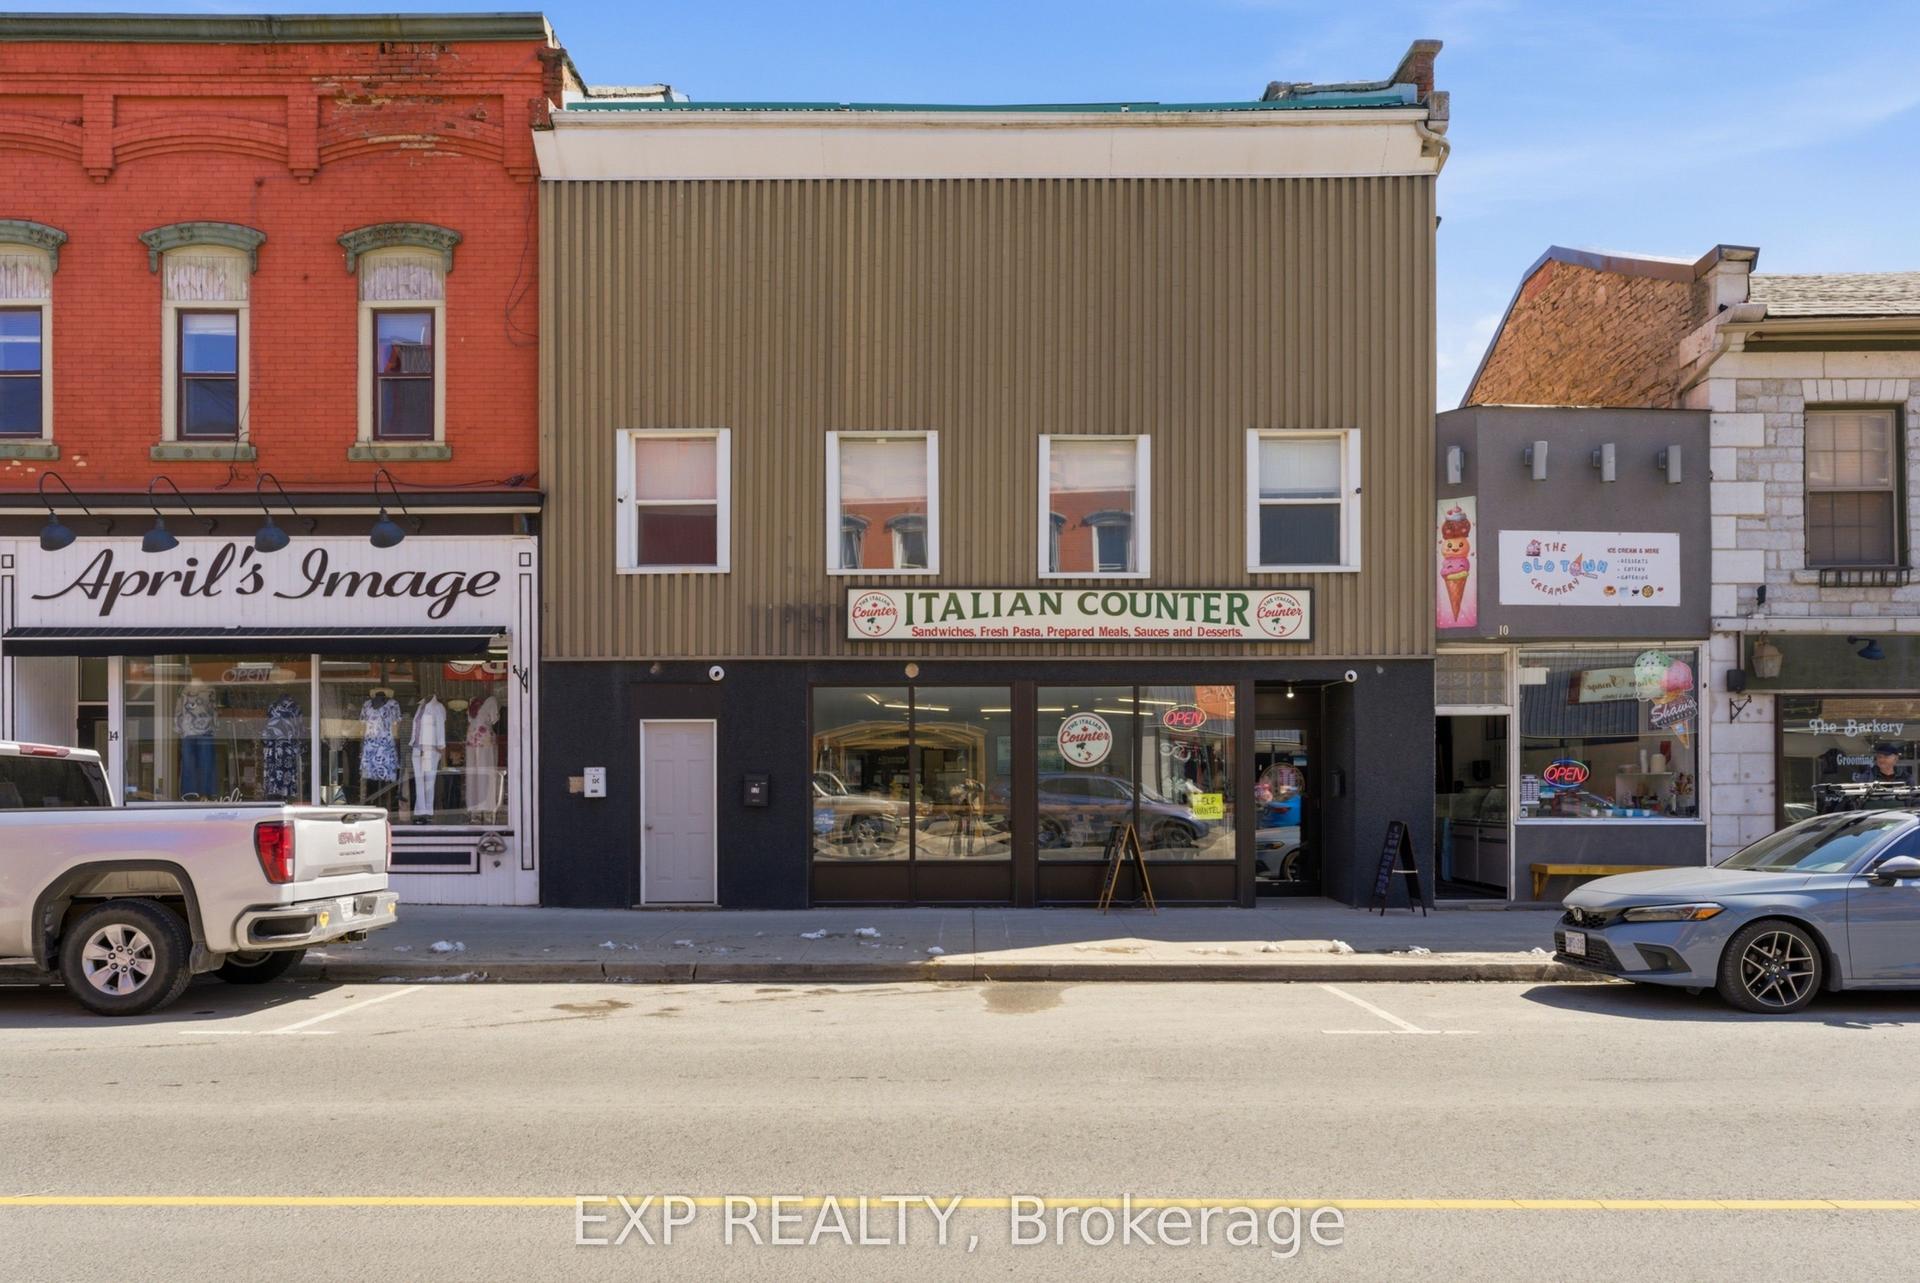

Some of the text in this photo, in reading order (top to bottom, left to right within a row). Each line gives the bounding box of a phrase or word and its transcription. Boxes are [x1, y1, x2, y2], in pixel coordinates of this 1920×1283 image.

[1544, 542, 1567, 552] THE
[1521, 557, 1555, 574] OLD
[31, 542, 501, 620] April's Image
[1530, 578, 1580, 596] CREAMERY
[852, 606, 898, 618] Counter
[904, 591, 1250, 627] ITALIAN COUNTER
[1257, 606, 1303, 619] Counter
[911, 626, 1243, 639] Sandwiches, Fresh Pasta, Prepared Meals, Sauces and Desserts.
[1499, 624, 1509, 636] 10
[222, 668, 270, 683] OPEN
[1067, 719, 1103, 731] THE ITALIAN
[1166, 711, 1202, 726] OPEN
[1808, 718, 1904, 737] The Barkery
[109, 731, 119, 741] 14
[1060, 730, 1111, 744] Counter
[1836, 754, 1875, 767] Grooming
[1546, 766, 1586, 781] OPEN
